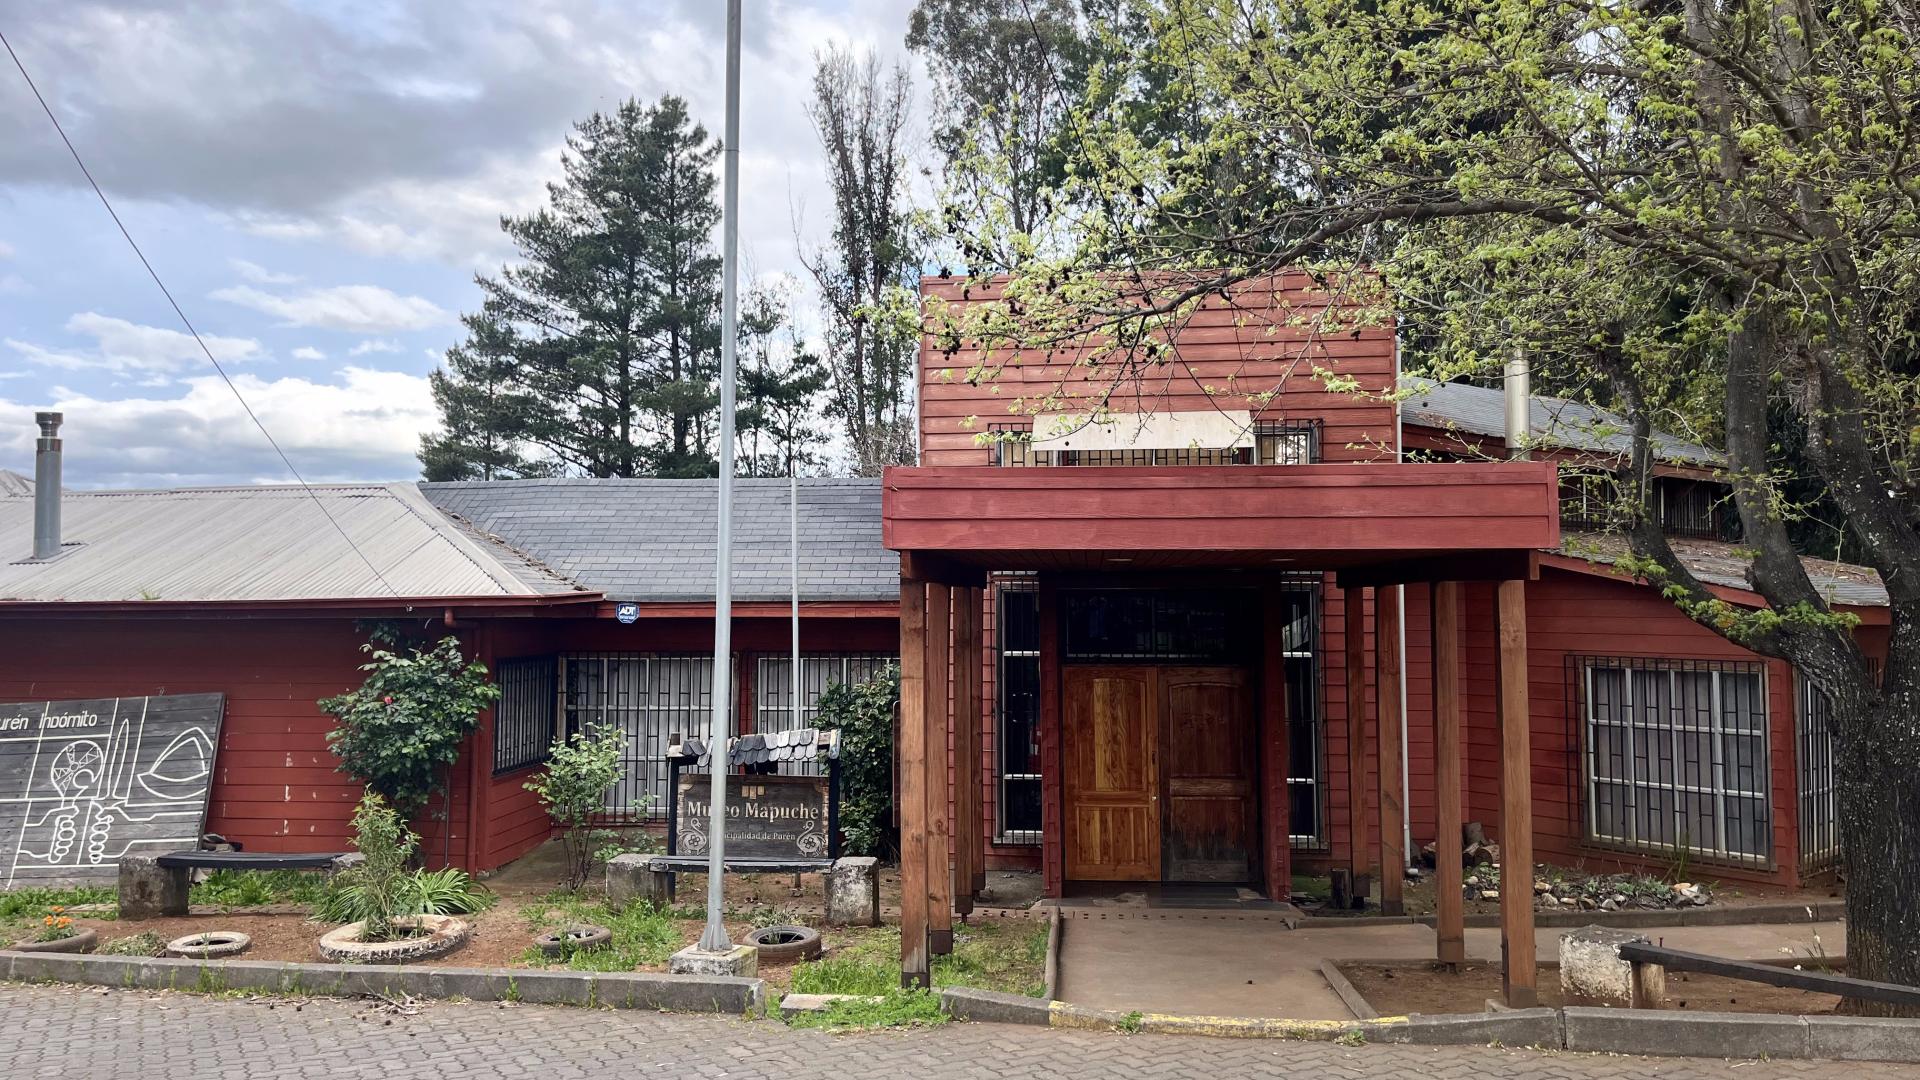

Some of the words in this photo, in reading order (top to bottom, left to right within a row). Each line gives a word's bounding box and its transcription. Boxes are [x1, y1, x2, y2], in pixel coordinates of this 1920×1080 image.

[619, 606, 635, 615] ADT
[0, 713, 29, 731] urén
[687, 801, 740, 818] Mueo
[745, 802, 819, 823] Mapuche
